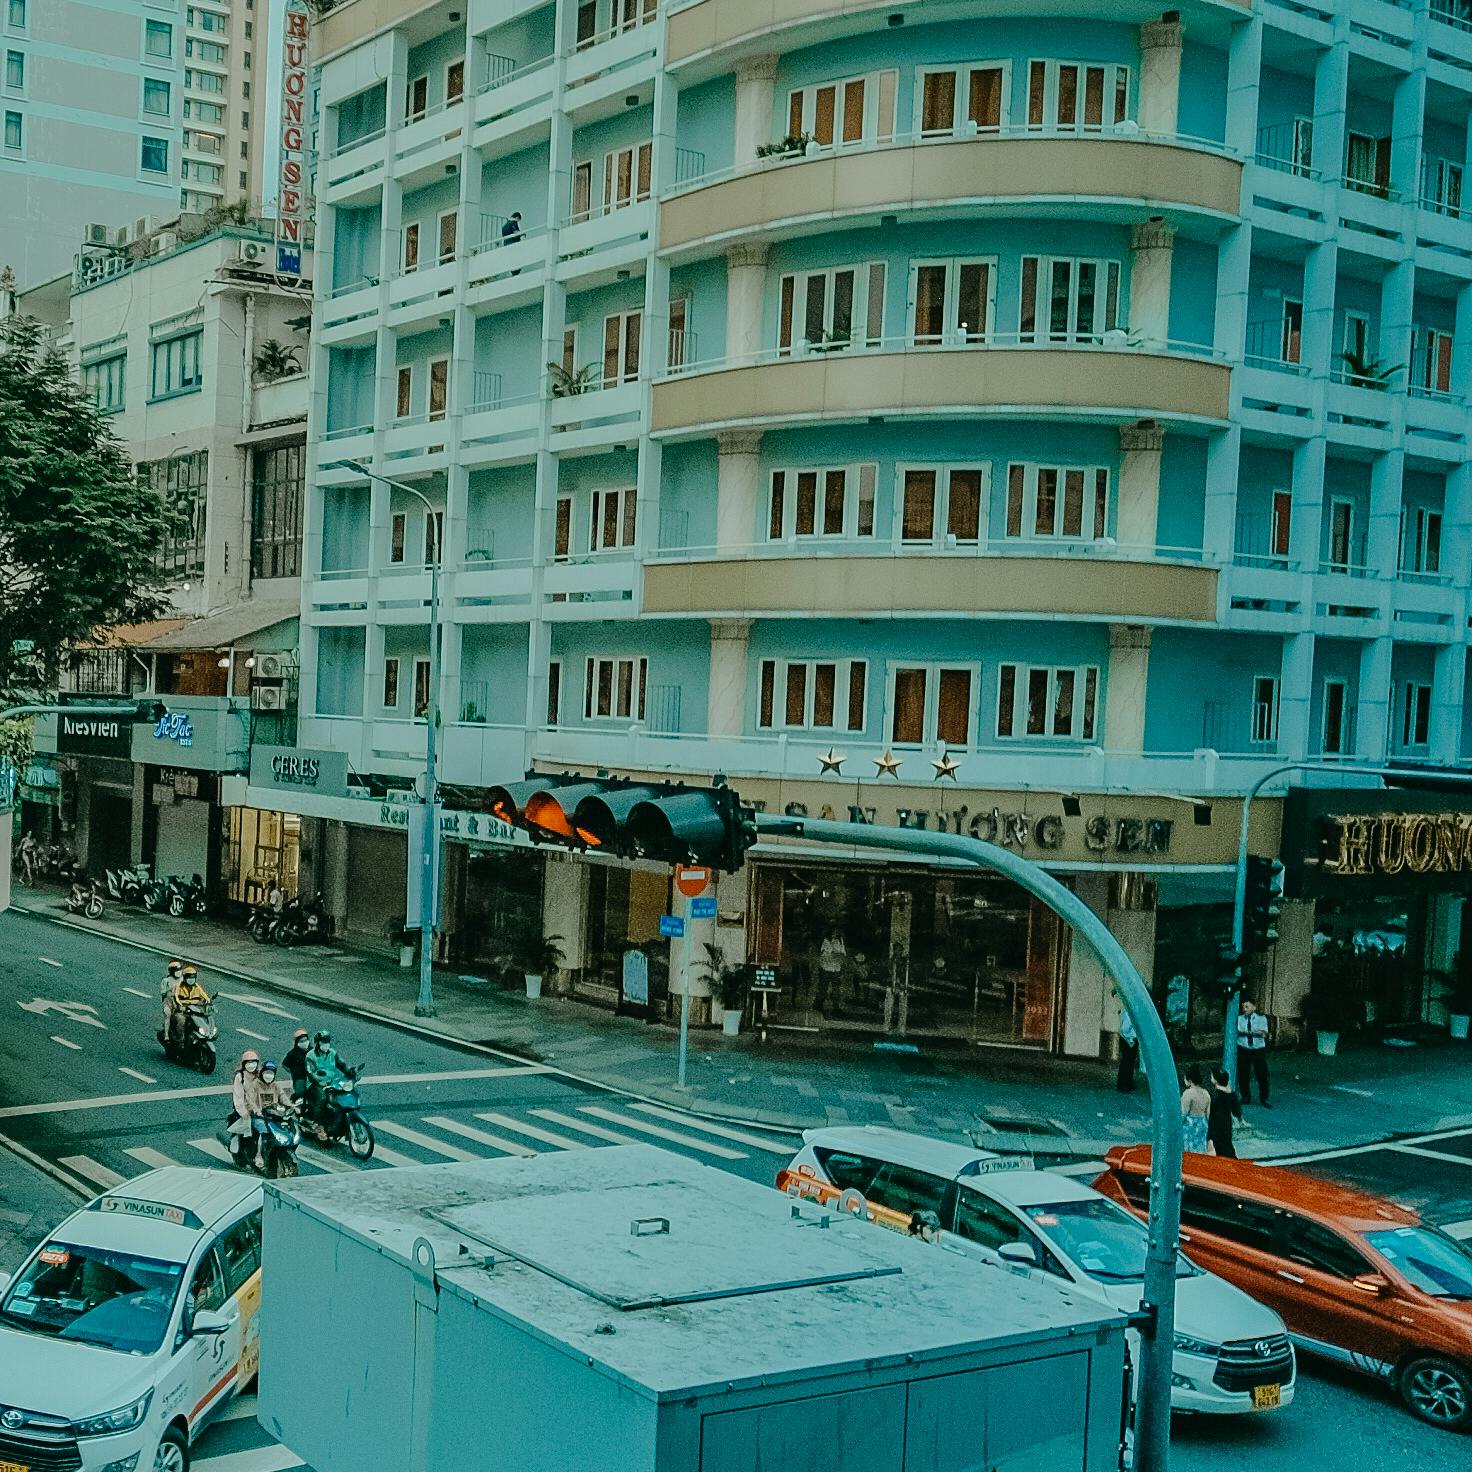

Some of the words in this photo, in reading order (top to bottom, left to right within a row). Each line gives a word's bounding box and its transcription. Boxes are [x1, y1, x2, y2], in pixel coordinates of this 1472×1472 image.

[281, 160, 302, 241] SEN
[271, 754, 319, 778] CERES
[1084, 816, 1174, 853] SEN
[124, 1201, 165, 1217] VINASUN
